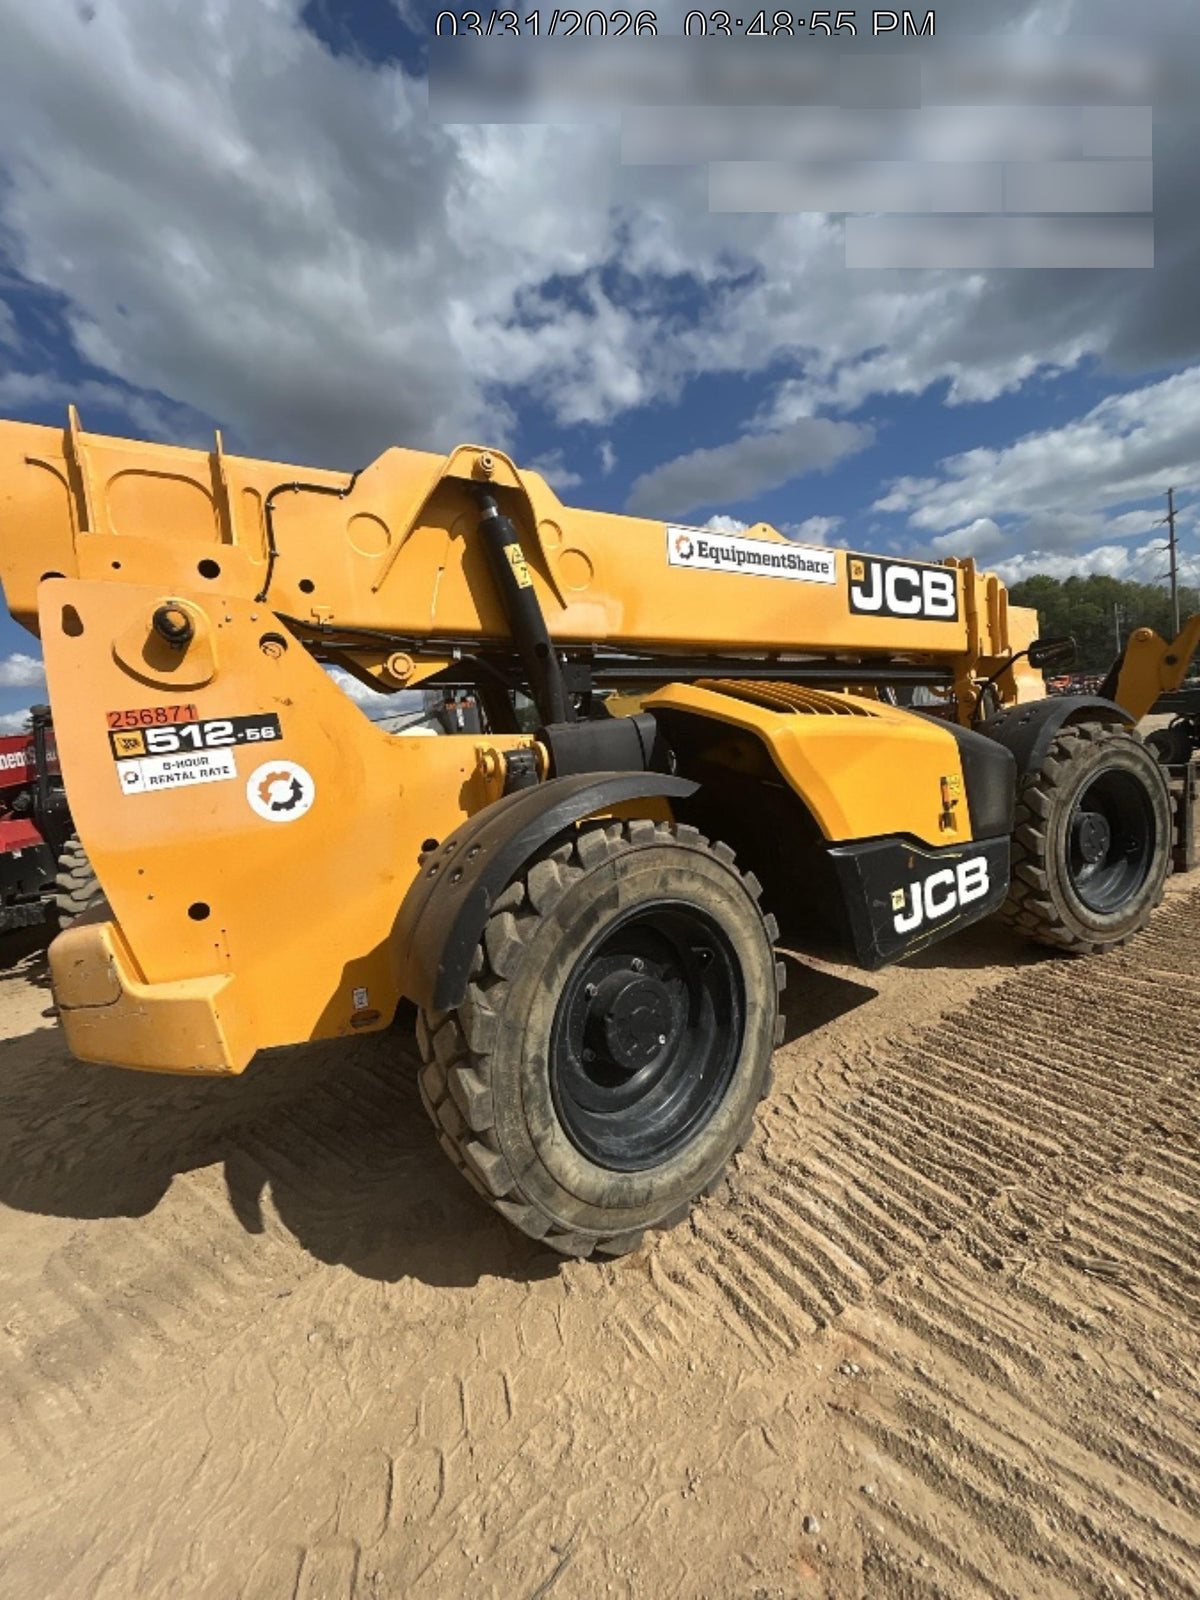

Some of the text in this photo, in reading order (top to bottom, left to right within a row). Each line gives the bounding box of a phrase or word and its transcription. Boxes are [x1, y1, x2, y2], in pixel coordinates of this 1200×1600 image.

[697, 541, 829, 574] EquipmentShare
[851, 562, 956, 617] JCB
[109, 704, 195, 728] 256871
[150, 766, 230, 785] RENTAL RATE
[893, 856, 989, 934] JCB
